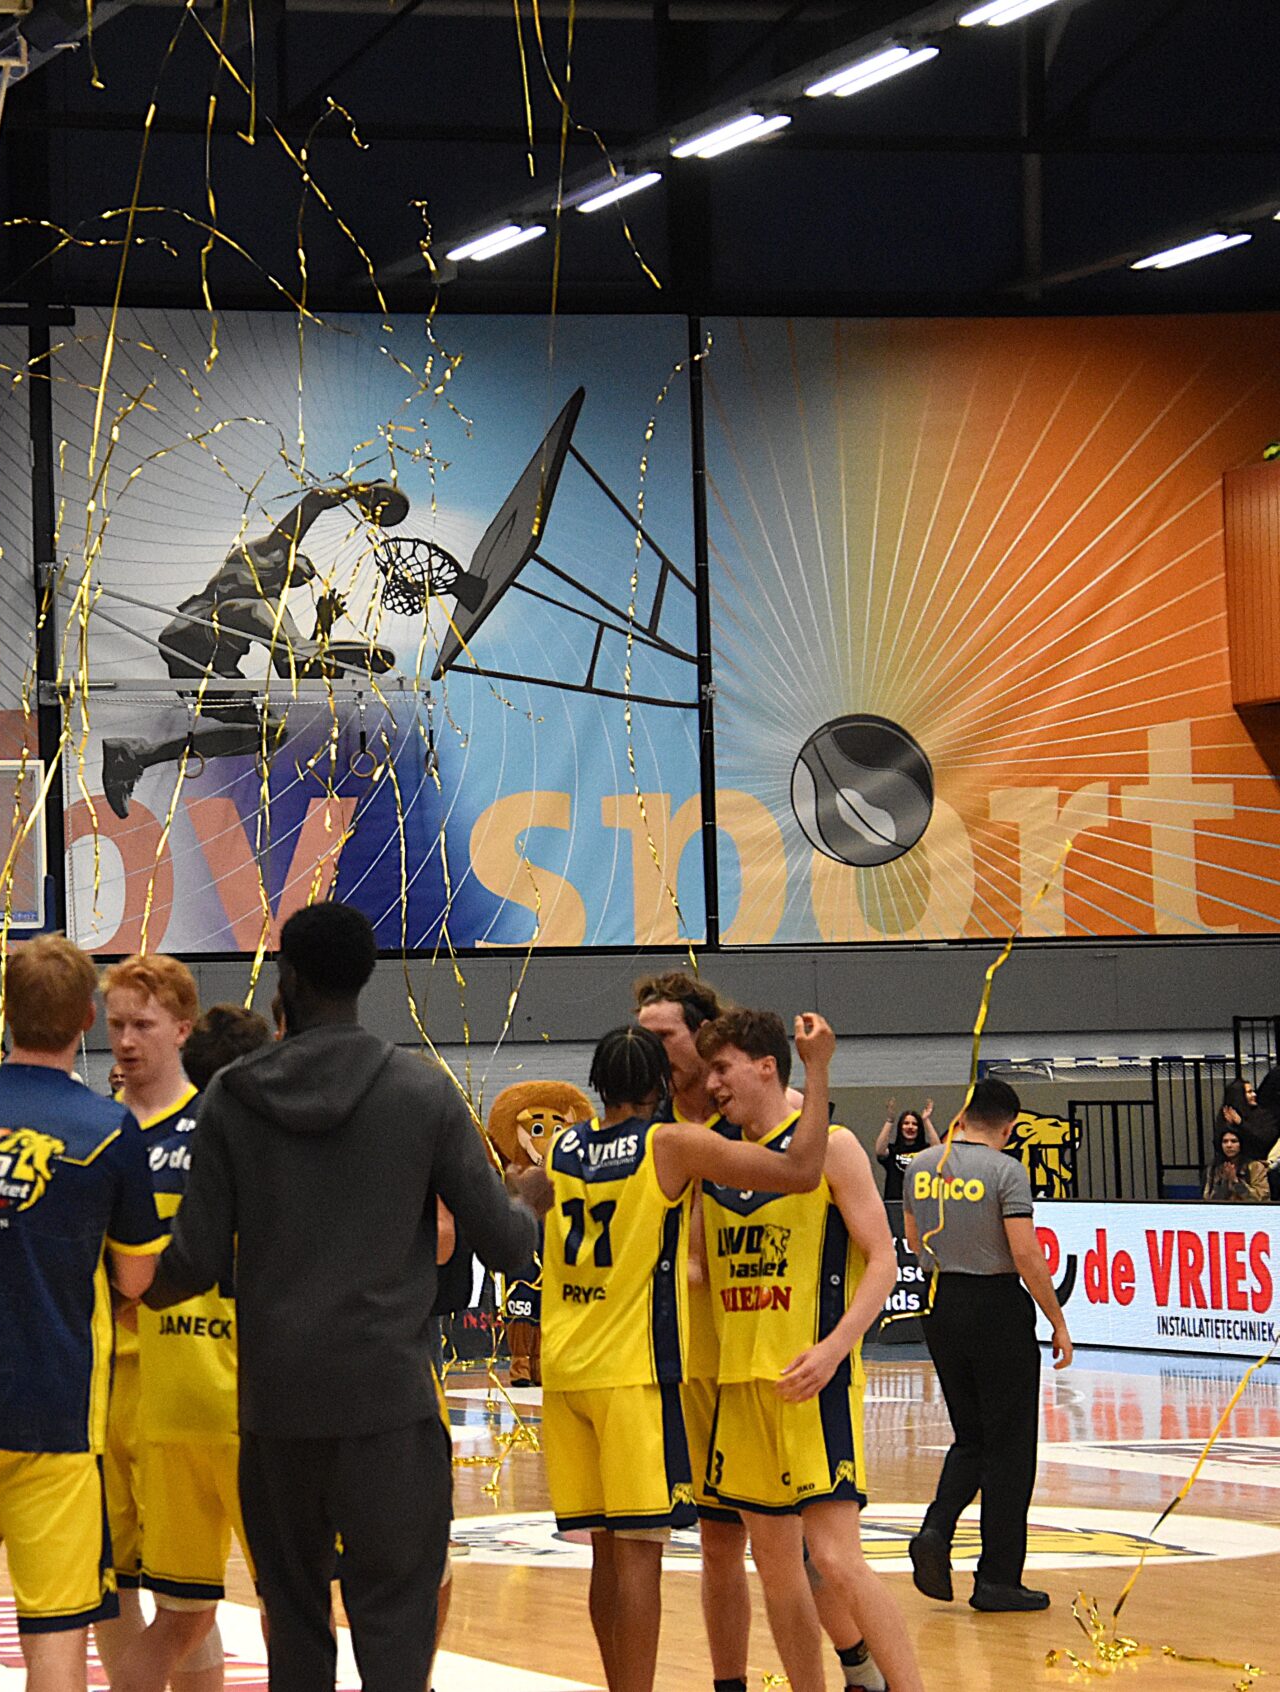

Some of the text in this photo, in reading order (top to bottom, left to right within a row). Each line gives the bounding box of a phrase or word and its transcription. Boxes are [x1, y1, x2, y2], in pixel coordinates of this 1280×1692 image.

[913, 1170, 985, 1202] Brico
[561, 1197, 617, 1268] 11
[1083, 1227, 1136, 1307] de
[1145, 1228, 1274, 1314] VRIES
[159, 1313, 232, 1340] JANECK
[1156, 1315, 1276, 1343] INSTALLATIETECHNIEK
